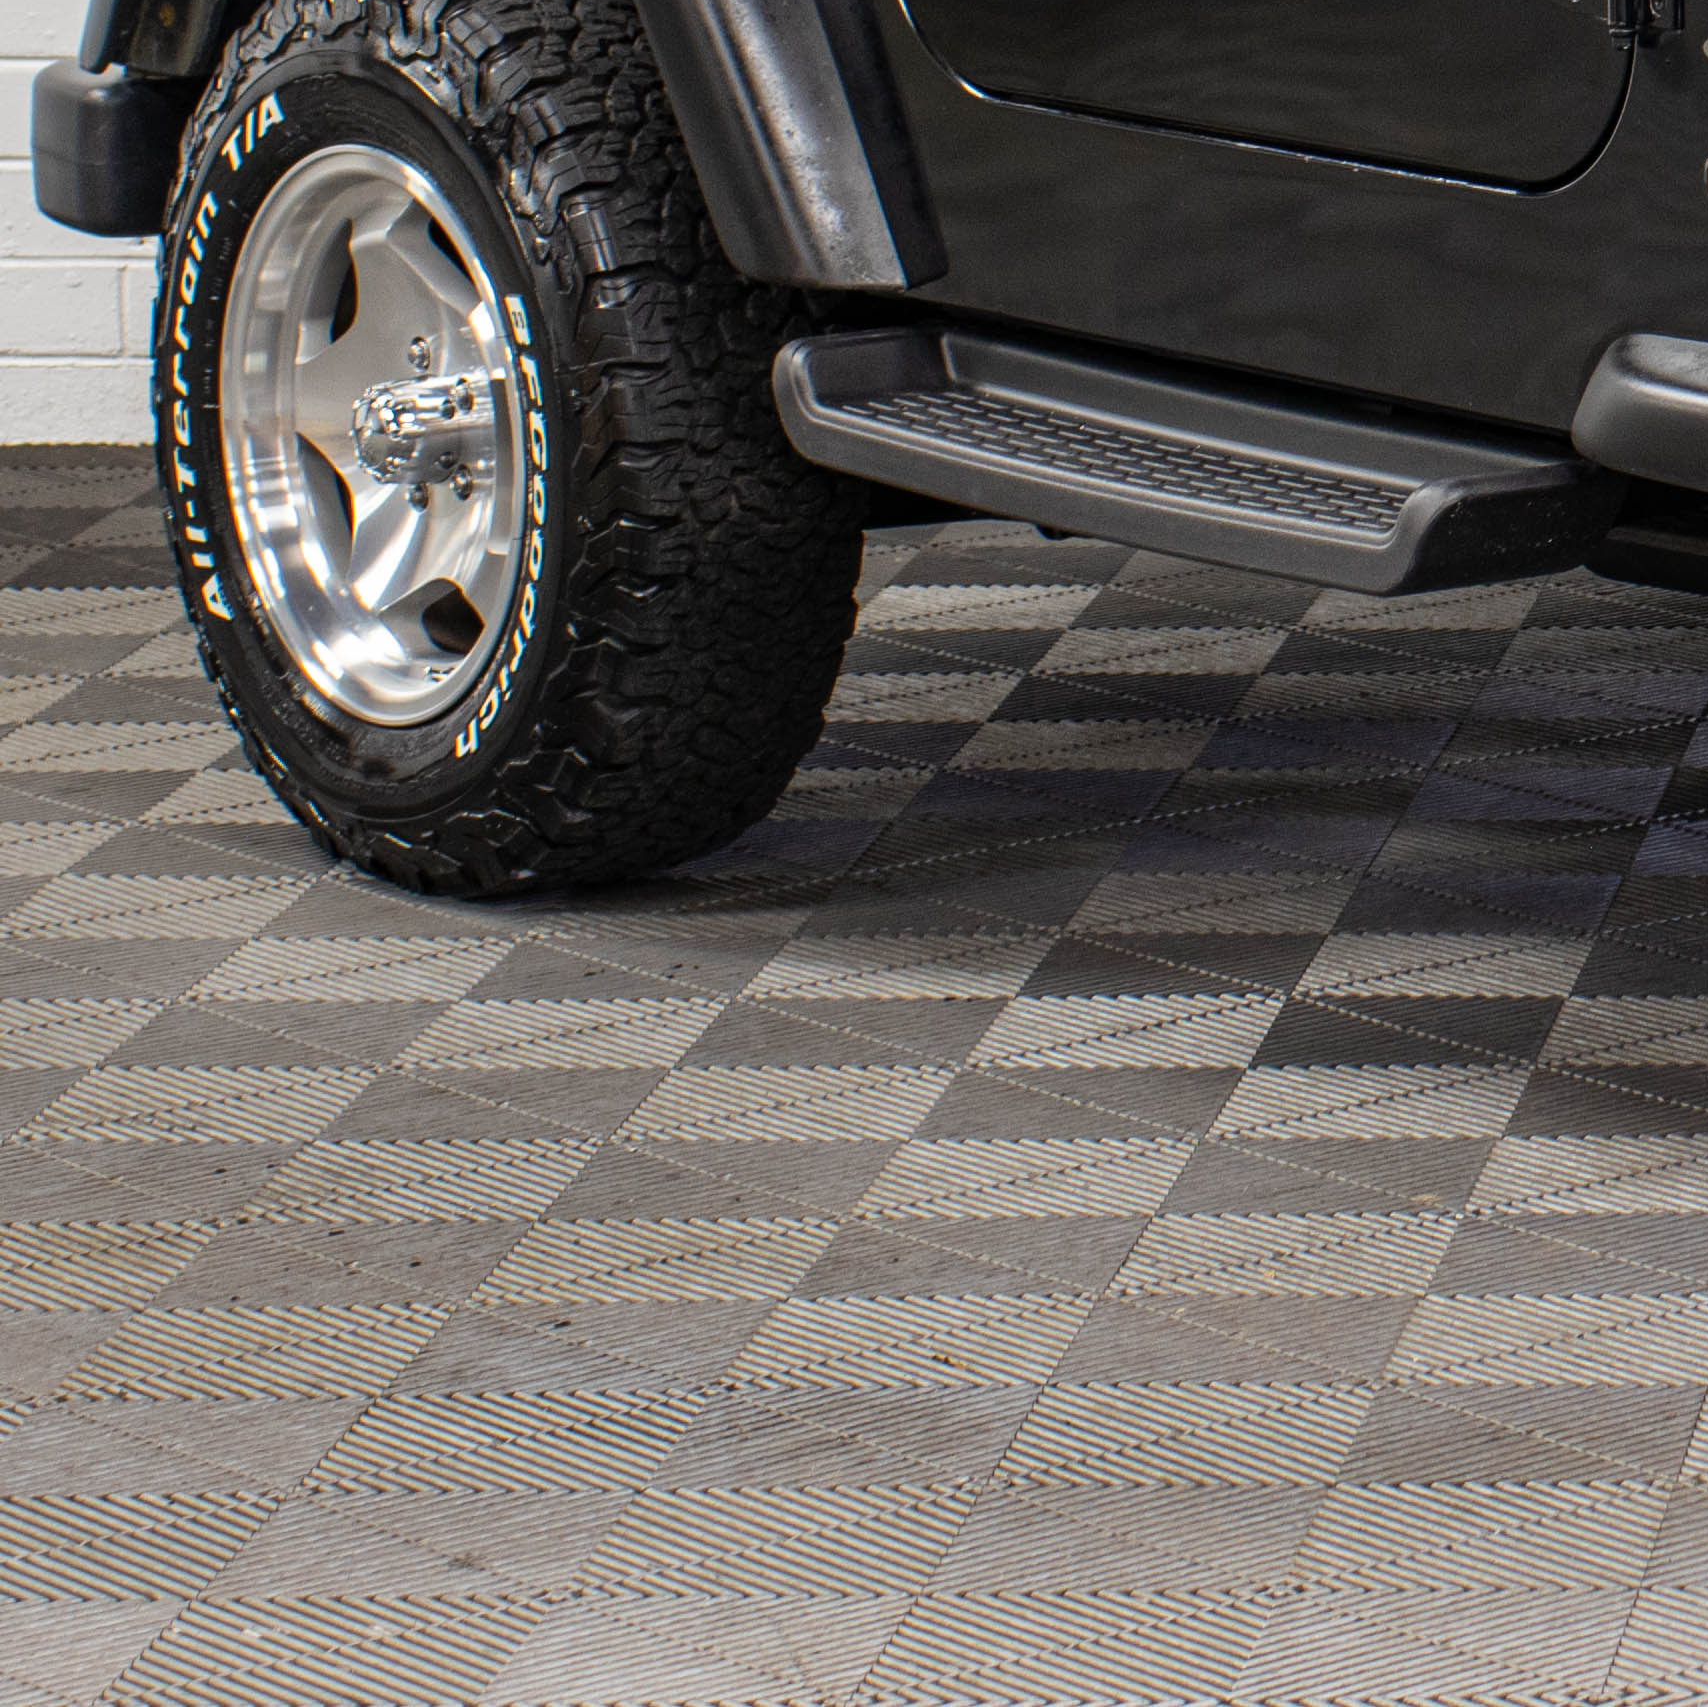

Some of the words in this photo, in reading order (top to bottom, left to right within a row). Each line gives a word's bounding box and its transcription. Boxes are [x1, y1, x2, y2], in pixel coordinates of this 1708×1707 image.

[172, 191, 234, 622] All-Terrain
[220, 91, 285, 172] T/A
[454, 294, 548, 760] BFGoodrich
